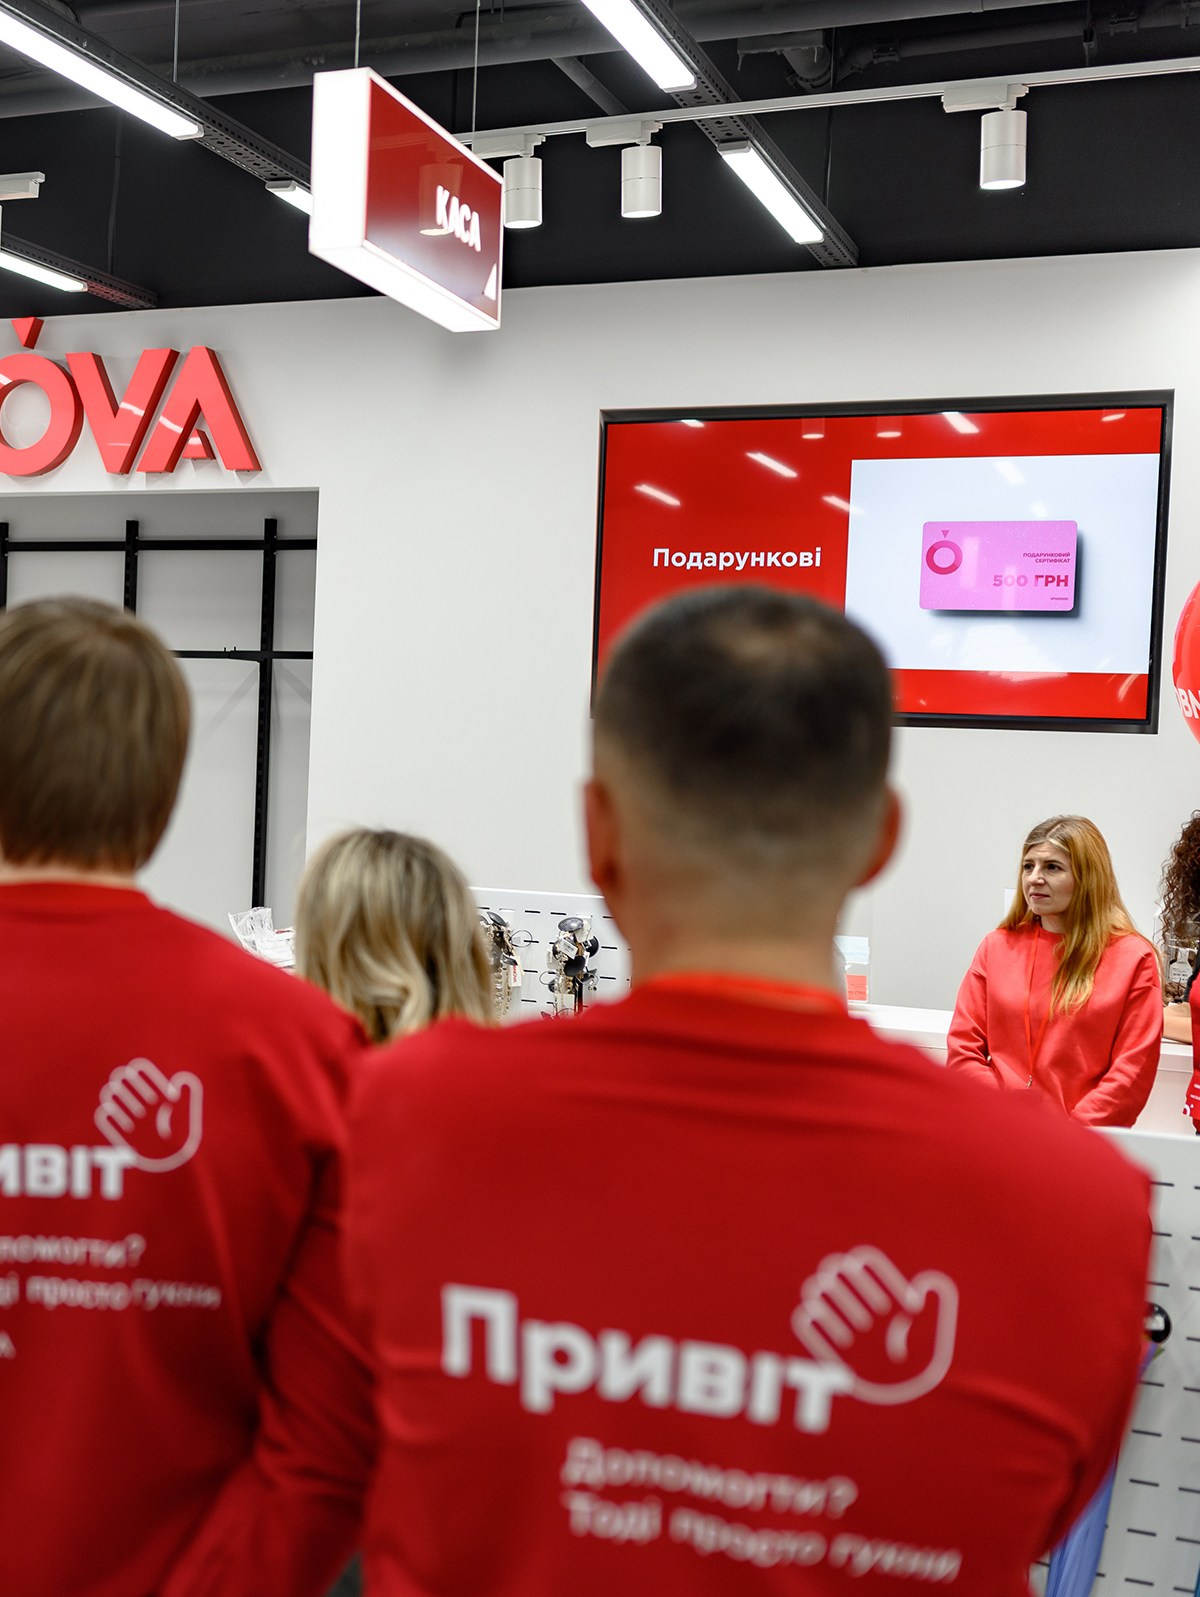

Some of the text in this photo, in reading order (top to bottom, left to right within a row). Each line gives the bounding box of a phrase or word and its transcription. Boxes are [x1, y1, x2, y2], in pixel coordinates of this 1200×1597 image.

[435, 185, 482, 252] КАСА
[653, 546, 822, 571] Подарункові
[992, 574, 1069, 588] 500 ГРН
[26, 1274, 132, 1311] просто
[441, 1282, 855, 1435] Привіт
[561, 1437, 858, 1518] Допомогти?
[562, 1490, 662, 1543] Тоді
[669, 1506, 827, 1568] просто
